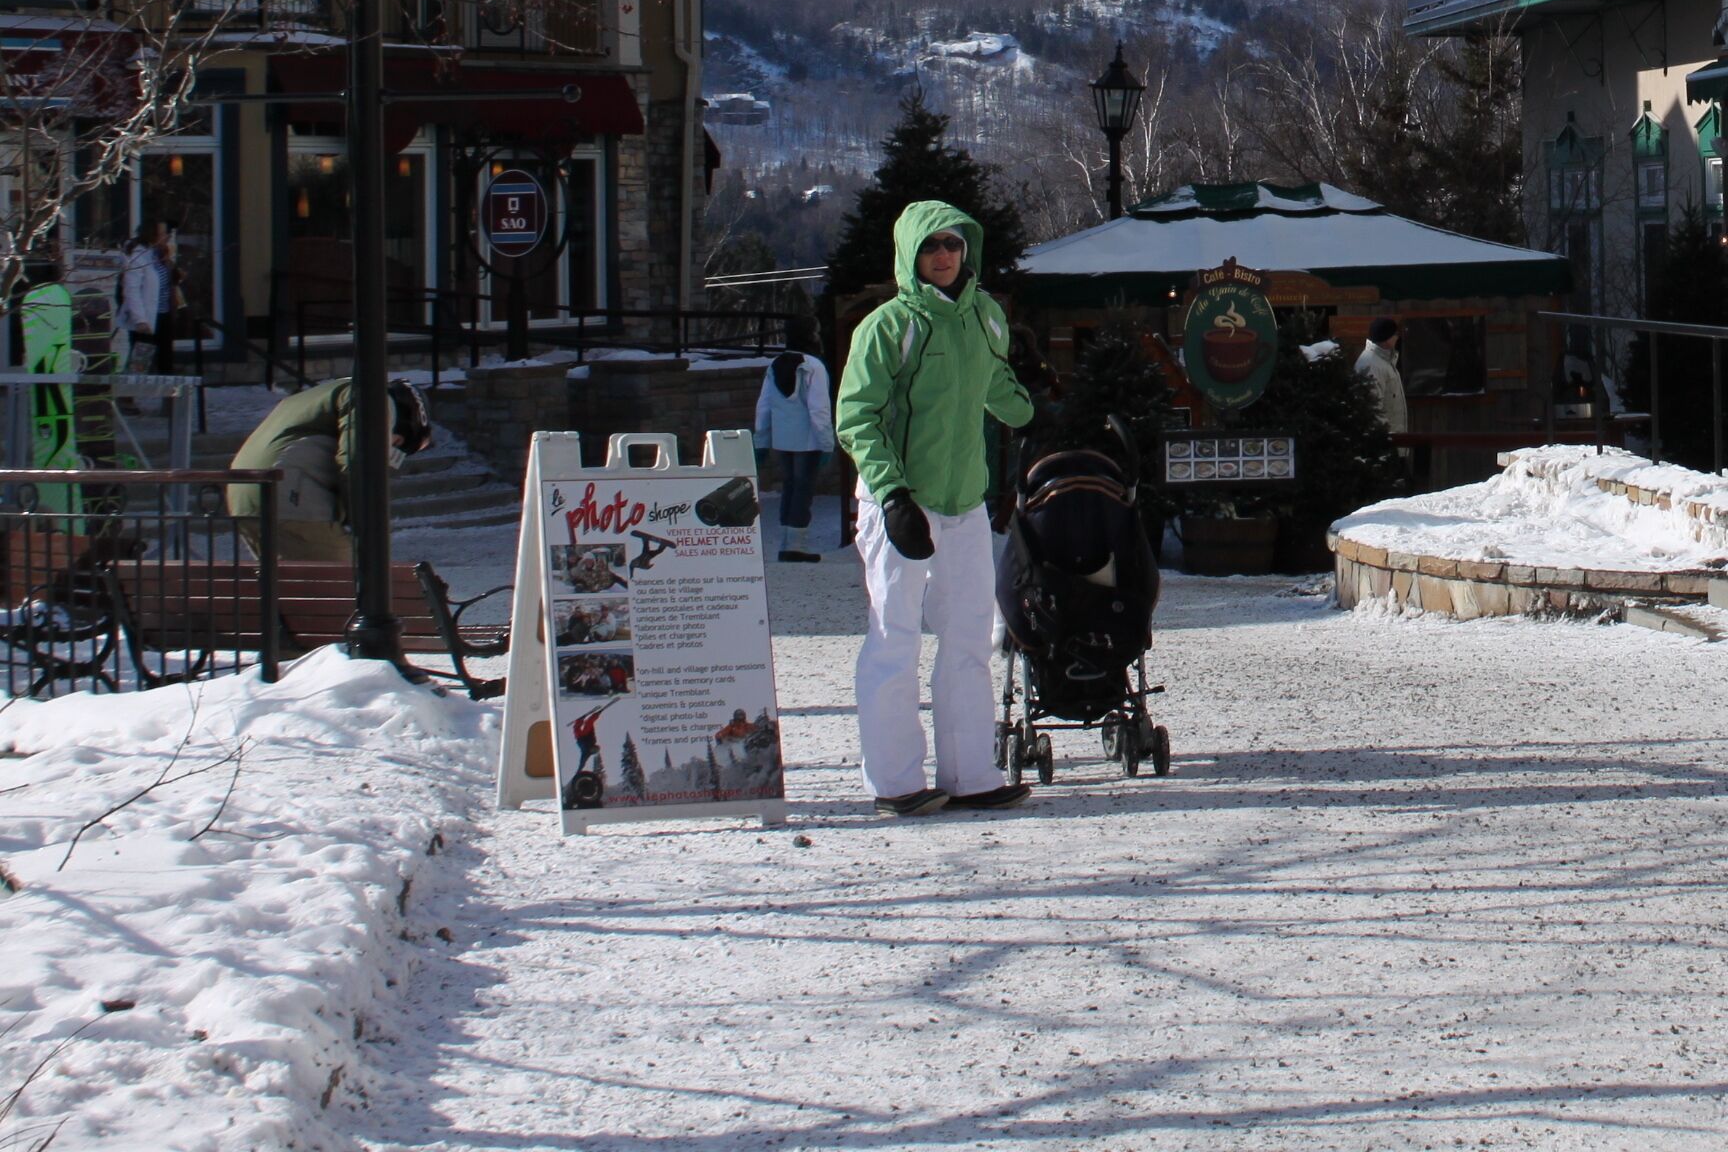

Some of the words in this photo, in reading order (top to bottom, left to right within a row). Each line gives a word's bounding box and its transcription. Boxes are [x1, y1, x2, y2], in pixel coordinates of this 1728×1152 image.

[1234, 268, 1262, 286] Bistro
[565, 482, 646, 545] photo
[649, 501, 692, 526] shoppe
[666, 528, 691, 537] VENTE
[694, 528, 705, 536] ET
[706, 527, 746, 536] LOCATION
[676, 536, 720, 546] HELMET
[722, 536, 752, 545] CAMS
[675, 549, 699, 558] SALES
[678, 576, 700, 586] photo
[726, 575, 763, 584] montagne
[679, 586, 703, 596] village
[680, 613, 720, 621] Tremblant
[667, 665, 681, 673] and
[684, 665, 709, 674] village
[711, 664, 734, 674] photo
[715, 675, 736, 684] cards
[670, 688, 711, 697] Tremblant
[688, 699, 726, 709] postcards
